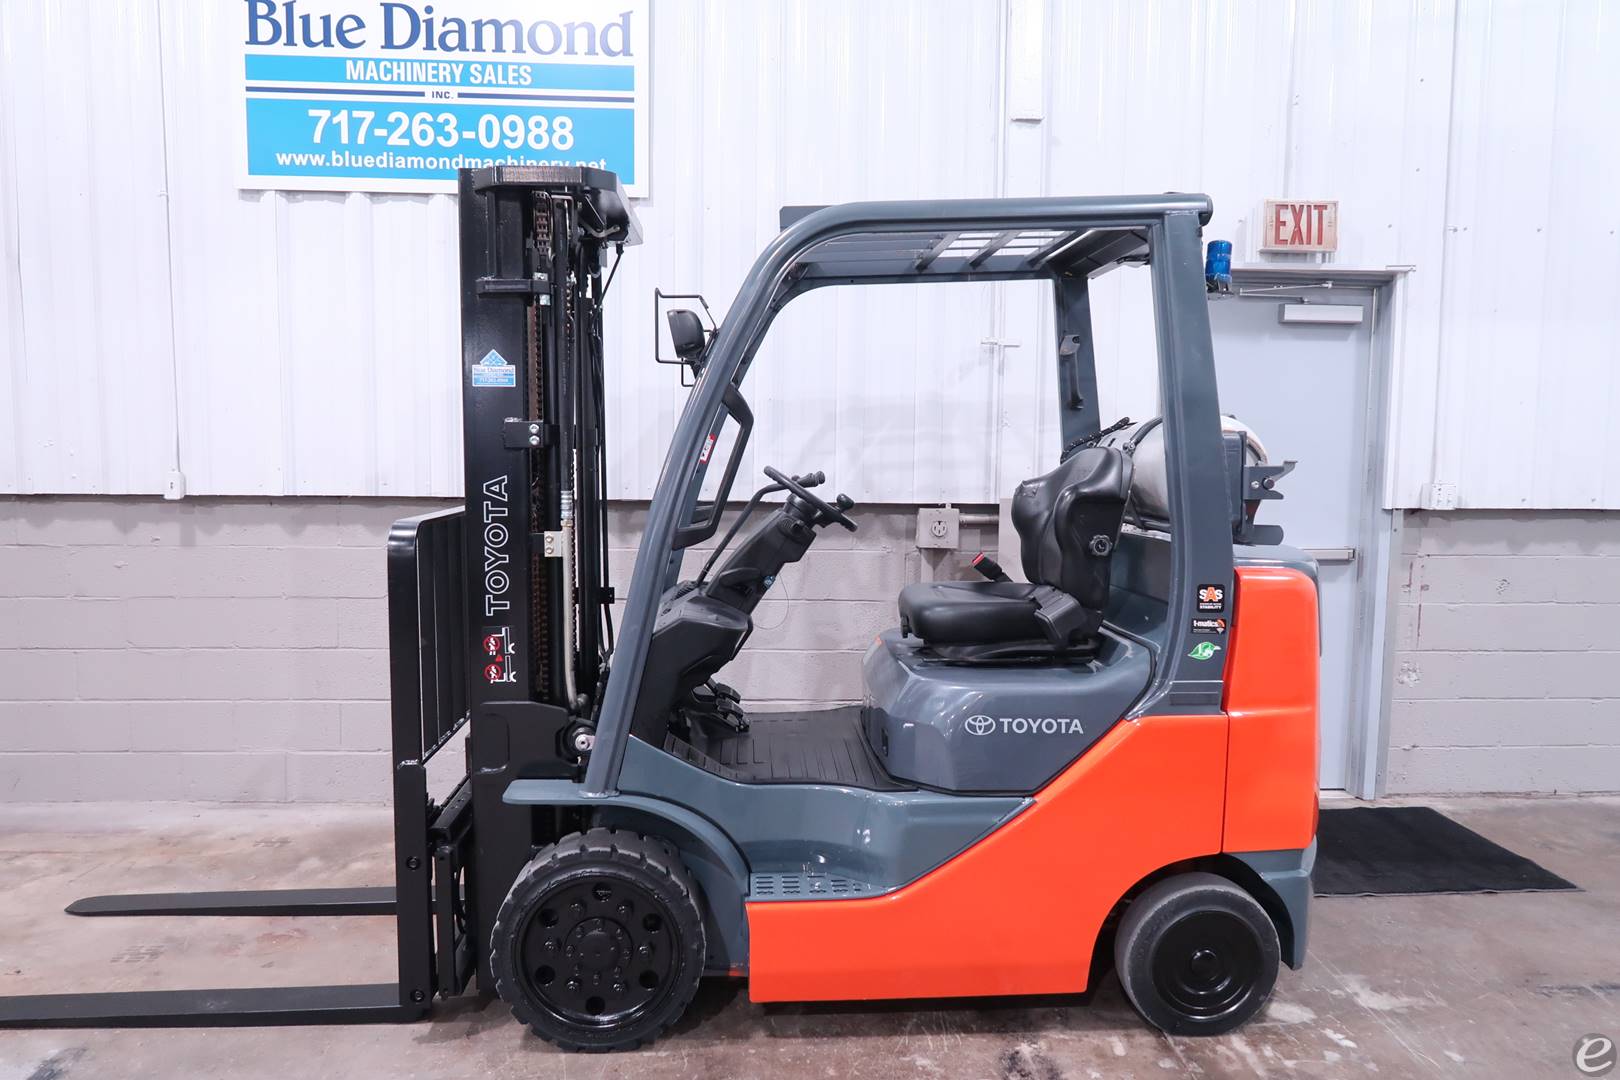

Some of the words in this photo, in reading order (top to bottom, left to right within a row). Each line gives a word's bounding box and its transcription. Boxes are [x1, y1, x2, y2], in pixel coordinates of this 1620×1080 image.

[245, 0, 366, 49] Blue
[380, 3, 634, 57] Diamond
[345, 59, 463, 84] MACHINERY
[469, 63, 532, 86] SALES
[431, 90, 454, 100] INC.
[308, 108, 575, 150] 717-263-0988
[276, 150, 606, 170] www.bluediamondmachinernet
[1275, 204, 1328, 245] EXIT
[483, 475, 509, 616] TOYOTA
[1199, 587, 1223, 602] SAS
[1000, 718, 1084, 734] TOYOTA
